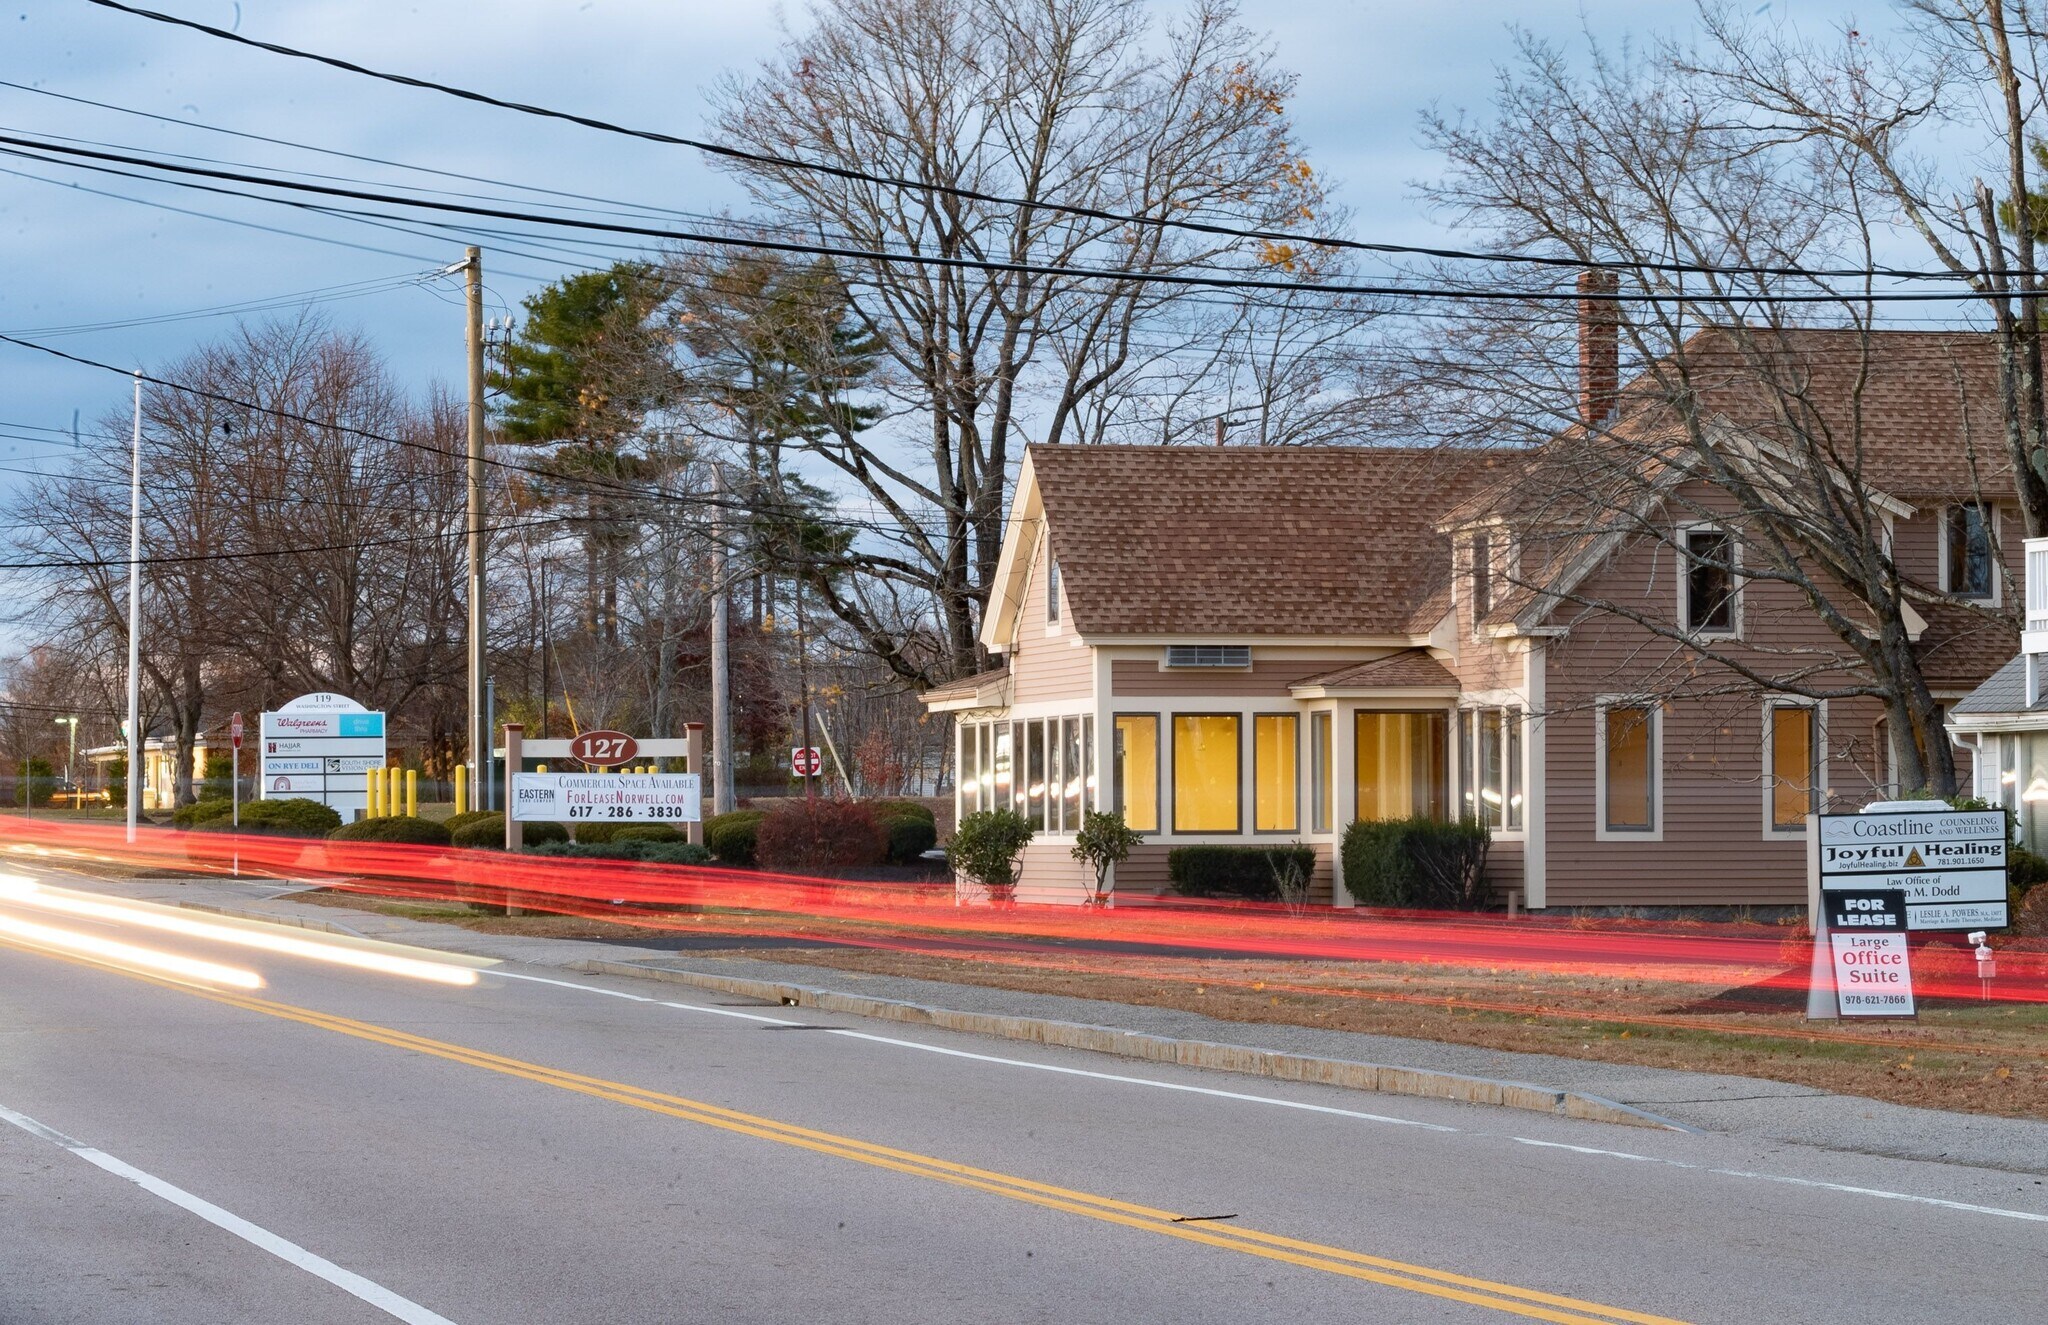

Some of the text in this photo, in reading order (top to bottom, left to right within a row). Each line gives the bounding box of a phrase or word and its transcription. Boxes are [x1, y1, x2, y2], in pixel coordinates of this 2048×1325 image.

[314, 694, 332, 703] 119
[276, 717, 328, 730] Walgreens
[582, 738, 627, 758] 127
[268, 762, 281, 770] ON
[283, 762, 299, 770] RYE
[558, 775, 695, 789] COMMERCIAL SPACE AVAILABLE
[519, 788, 555, 799] EASTERN
[569, 806, 593, 818] 617
[608, 806, 633, 818] 286
[647, 806, 683, 818] 3830
[1853, 819, 1934, 837] Coastline
[1940, 817, 1997, 827] COUNSELING
[1938, 825, 1999, 836] AND WELLNESS
[1827, 842, 2002, 862] Joyful Healing
[1838, 860, 1899, 870] JoyfulHealing.biz
[1937, 857, 1985, 866] 781.901.1650
[1886, 875, 1942, 886] Law Office of
[1914, 887, 1928, 897] M.
[1931, 885, 1960, 897] Dodd
[1845, 899, 1885, 911] FOR
[1837, 914, 1897, 926] LEASE
[1920, 910, 1941, 919] LESLIE
[1942, 909, 1950, 918] A.
[1851, 937, 1890, 950] Large
[1842, 951, 1902, 965] Office
[1850, 969, 1899, 983] Suite
[1845, 995, 1906, 1004] 978-621-7866
